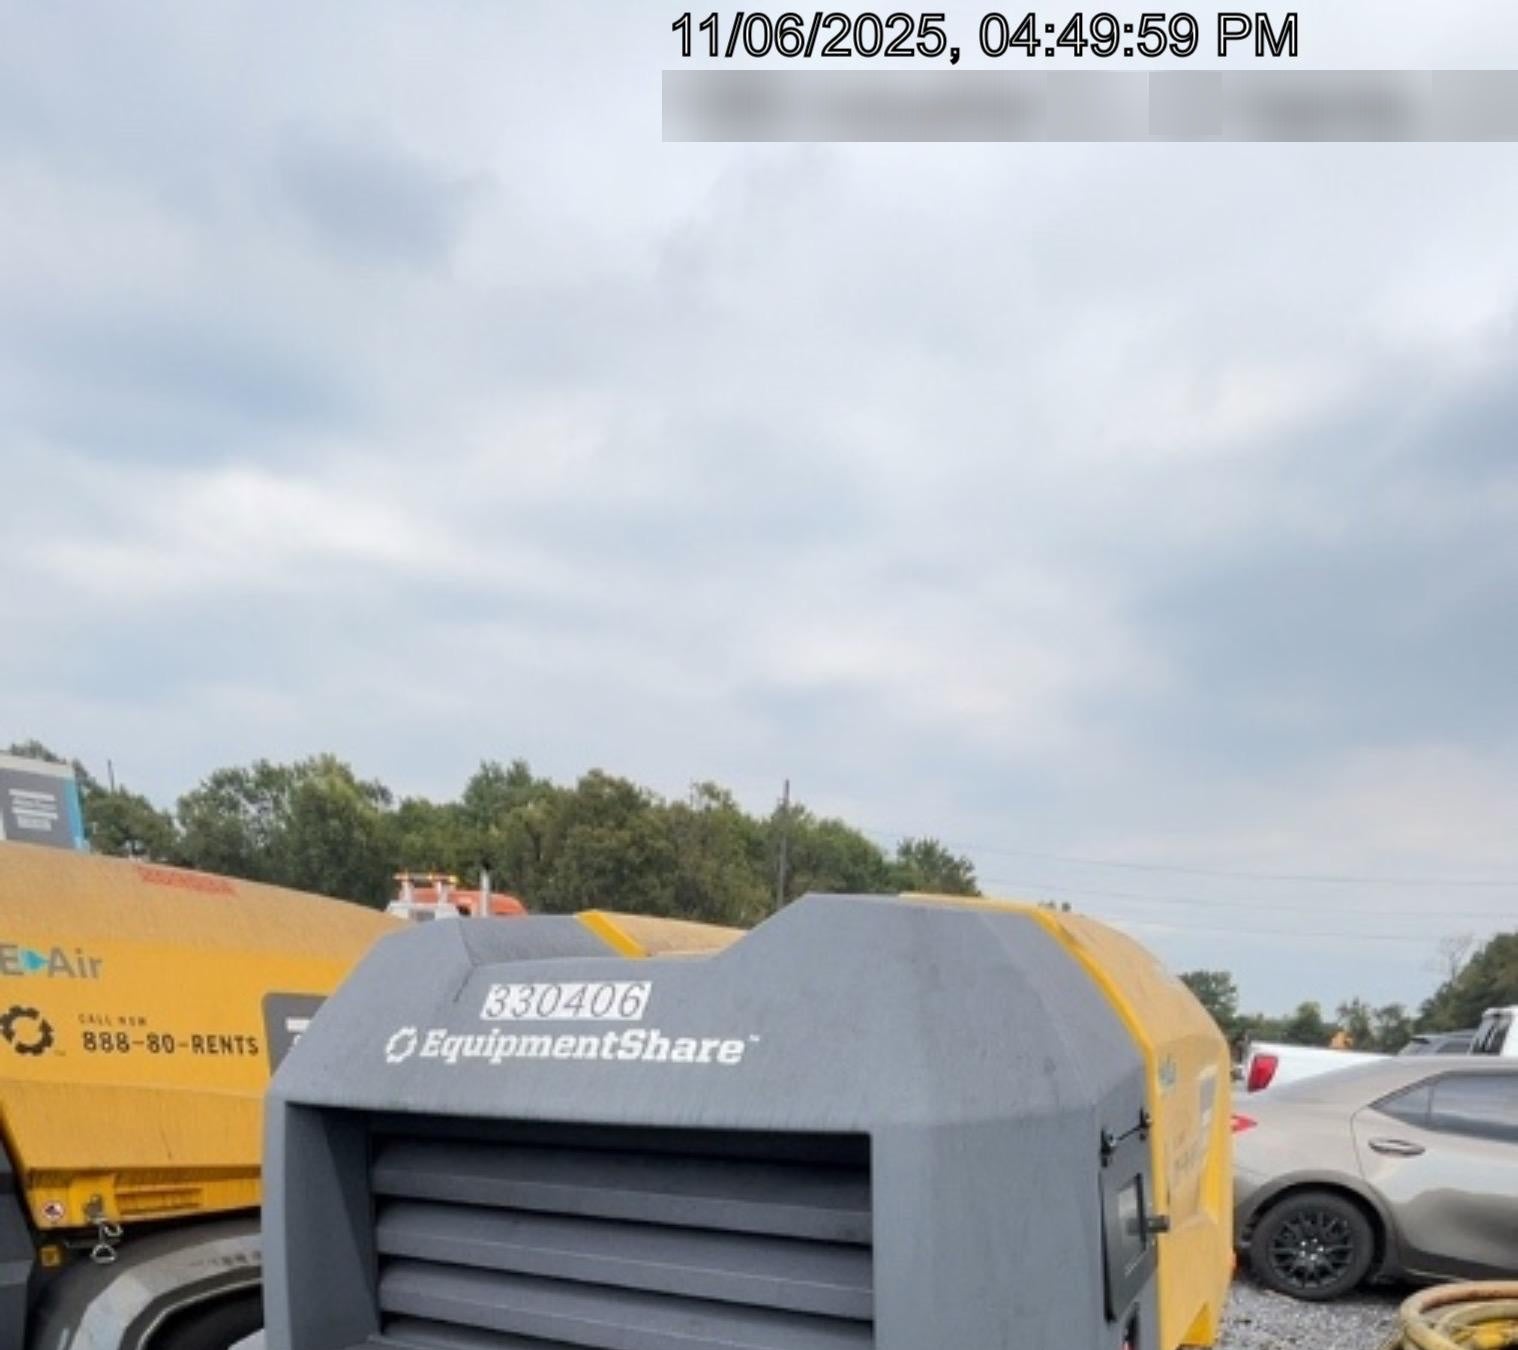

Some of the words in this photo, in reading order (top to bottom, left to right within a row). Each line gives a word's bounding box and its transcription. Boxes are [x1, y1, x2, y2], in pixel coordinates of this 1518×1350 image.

[485, 982, 646, 1018] 330406
[82, 1030, 260, 1056] 888-80-RENTS
[420, 1028, 745, 1065] EquipmentShare
